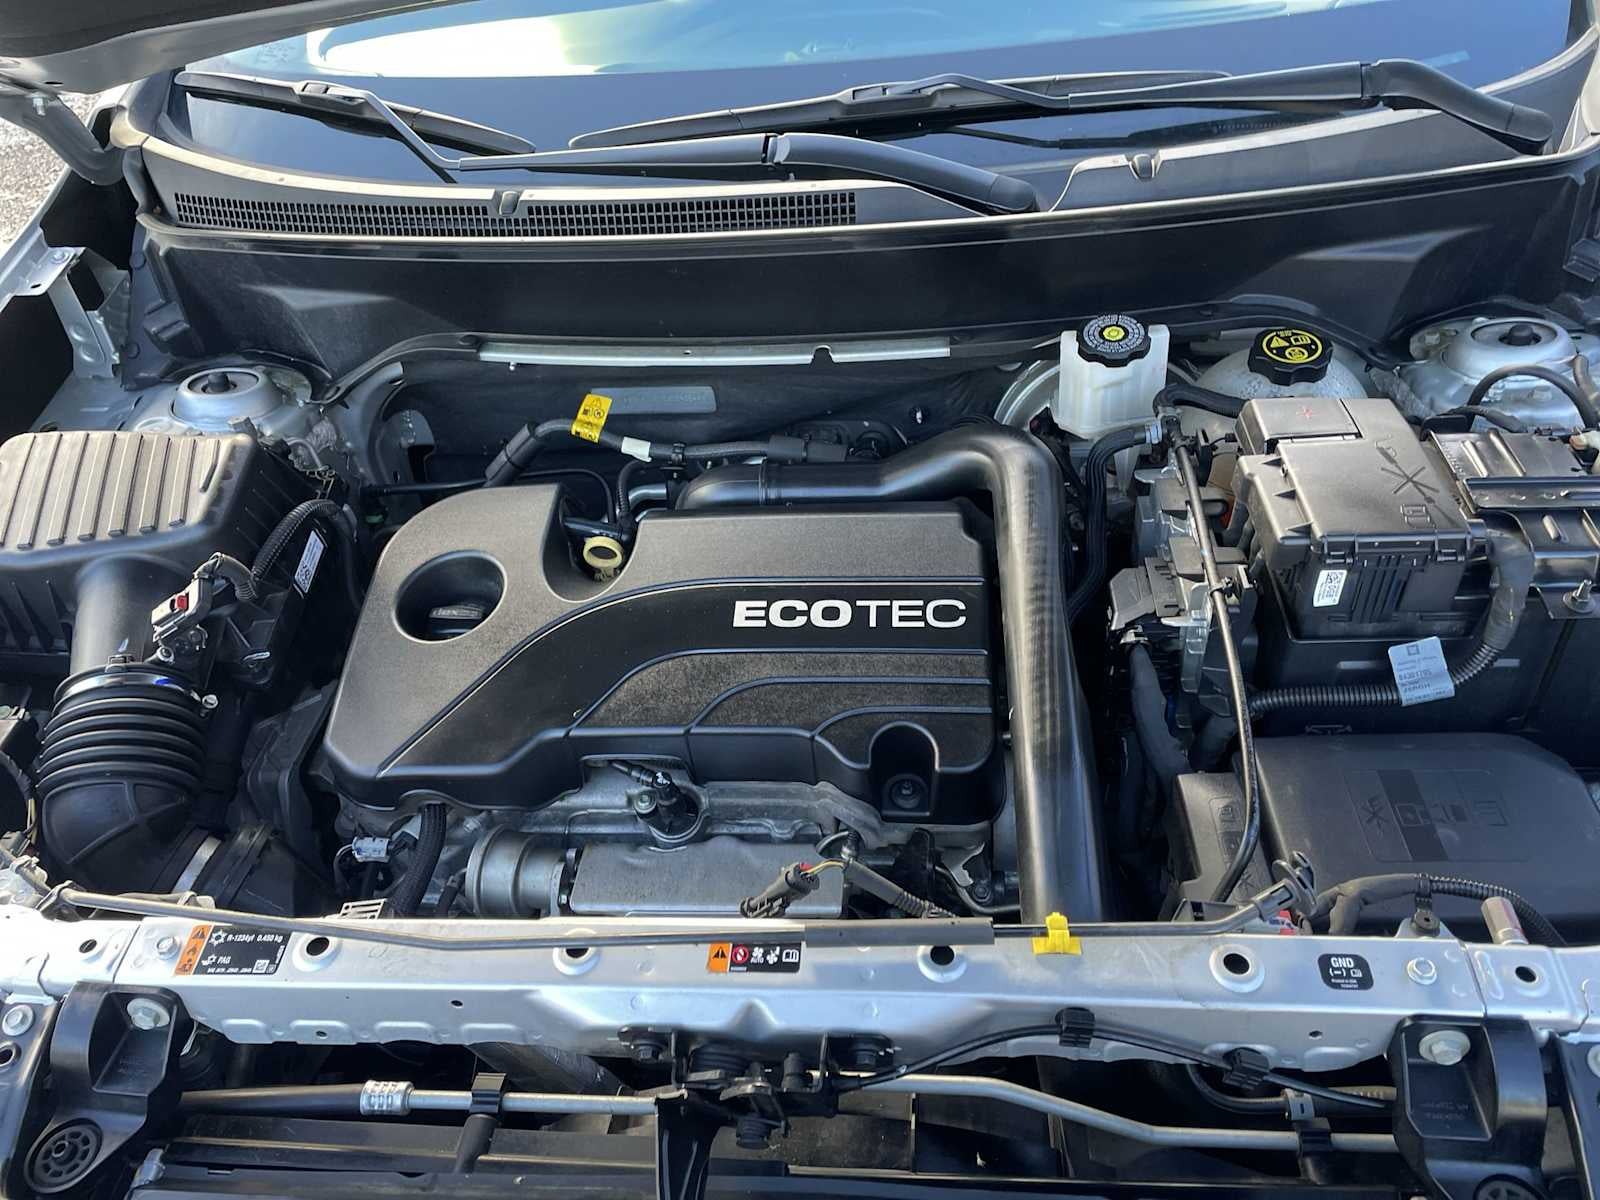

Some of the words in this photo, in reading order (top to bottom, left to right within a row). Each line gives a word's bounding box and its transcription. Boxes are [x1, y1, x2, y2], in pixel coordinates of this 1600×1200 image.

[733, 599, 967, 628] ECOTEC
[274, 934, 284, 943] kg
[1330, 956, 1355, 968] GND
